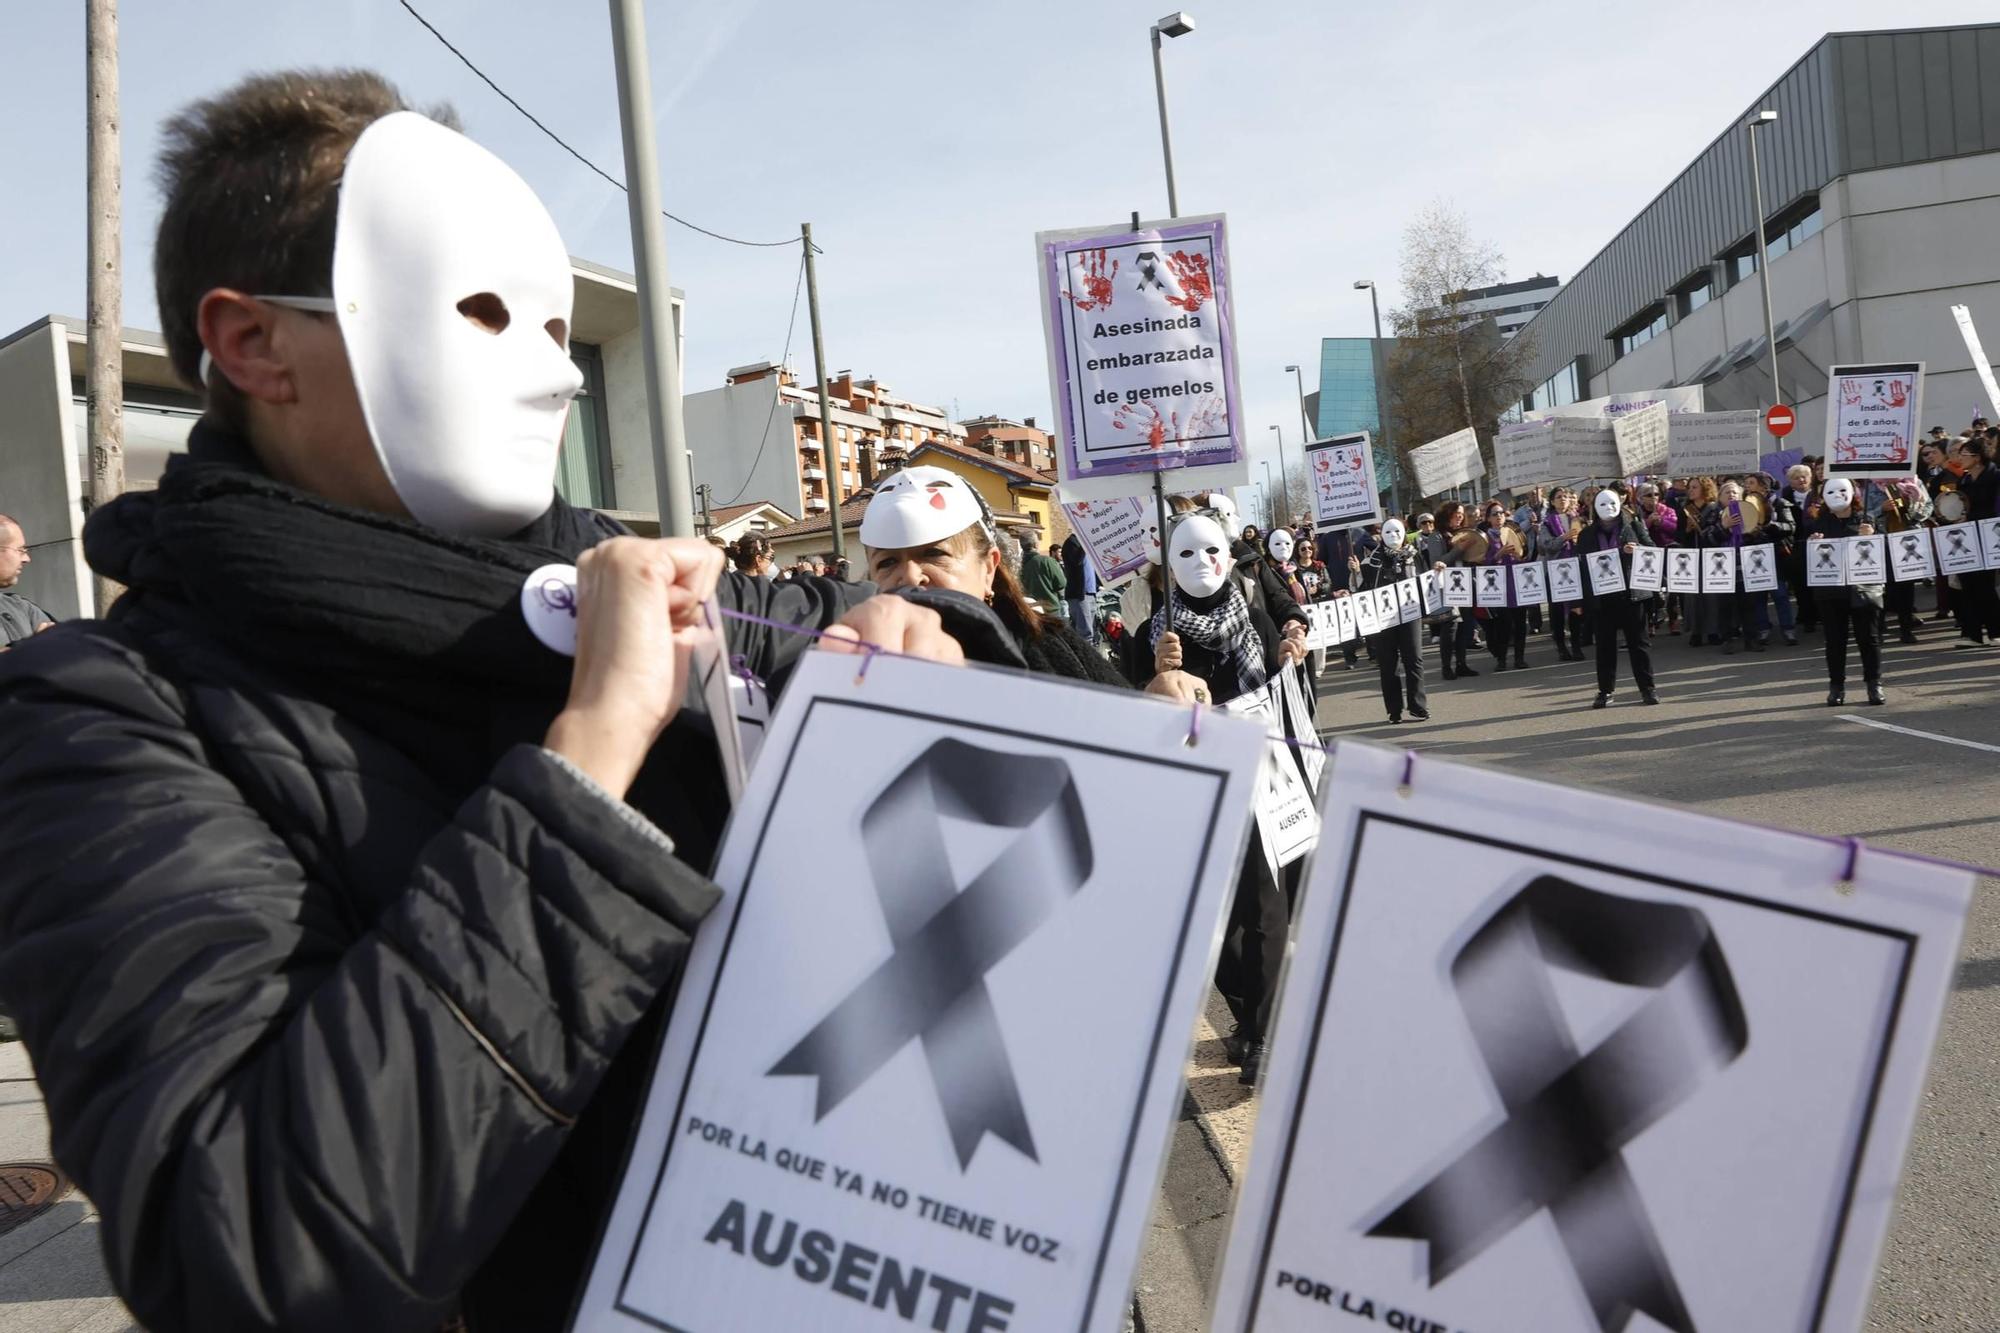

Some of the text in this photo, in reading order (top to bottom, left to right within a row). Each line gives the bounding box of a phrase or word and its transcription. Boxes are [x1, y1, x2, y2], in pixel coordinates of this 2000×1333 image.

[1093, 314, 1201, 338] Asesinada
[1086, 344, 1214, 370] embarazada
[1094, 380, 1214, 404] de gemelos
[1604, 400, 1661, 412] FEMINIST
[1324, 491, 1363, 502] Asesinada
[1346, 500, 1368, 510] padre
[1092, 506, 1113, 519] Mujer
[1112, 512, 1130, 524] años
[1092, 519, 1140, 546] asesinada por
[1279, 808, 1308, 830] AUSENTE
[686, 1116, 1064, 1262] POR LA QUE YA NO TIENE VOZ
[703, 1198, 1015, 1333] AUSENTE
[1276, 1270, 1333, 1305] POR
[1340, 1292, 1375, 1320] LA
